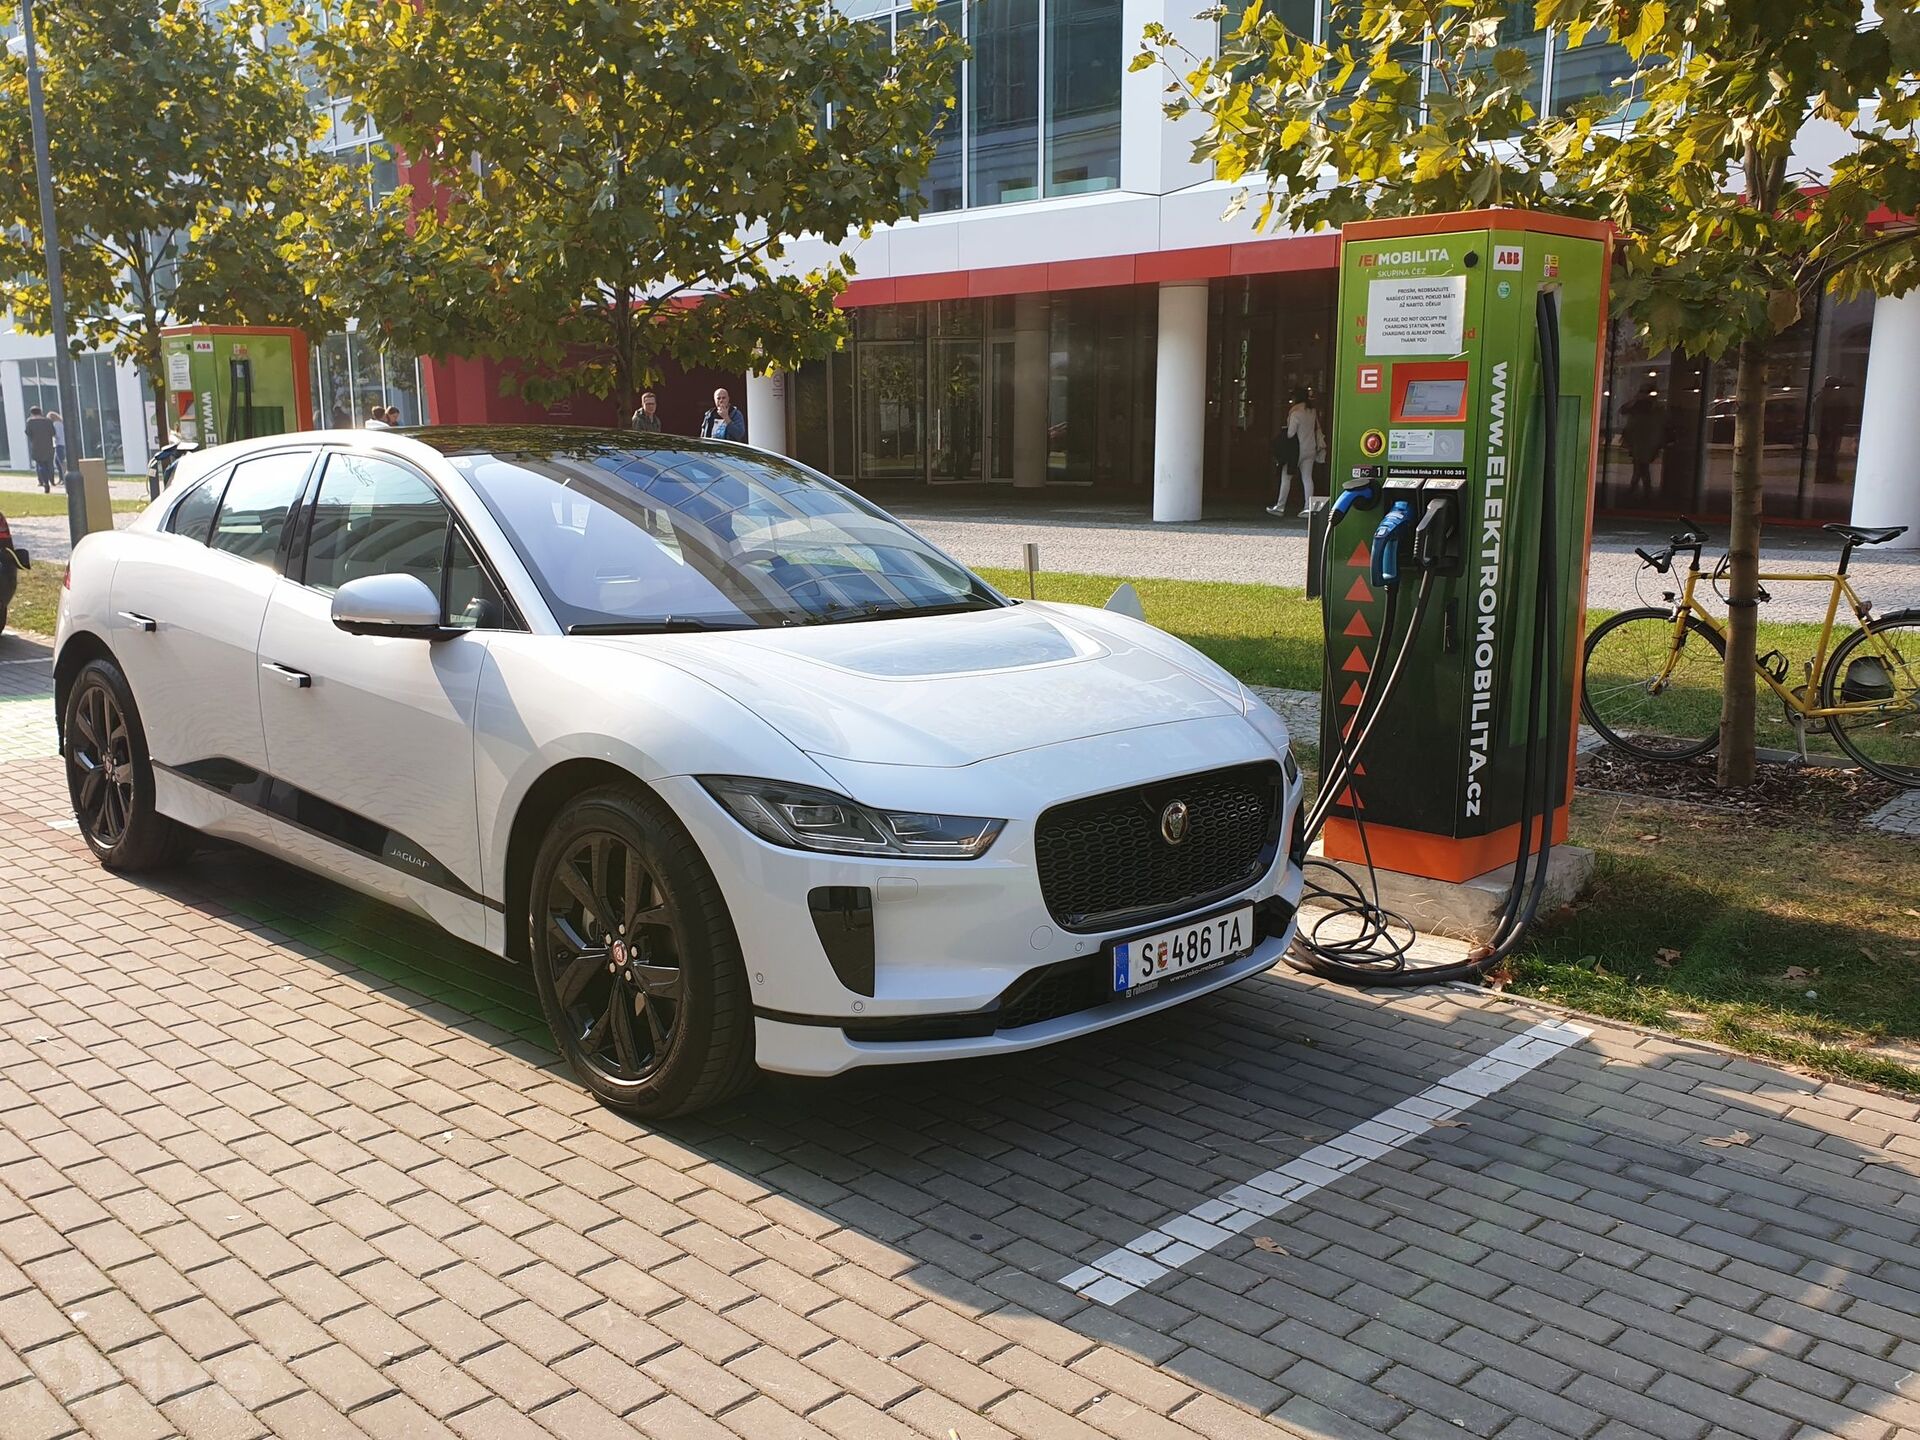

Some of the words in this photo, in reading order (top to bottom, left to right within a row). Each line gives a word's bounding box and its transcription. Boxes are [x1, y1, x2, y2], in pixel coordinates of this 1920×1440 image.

[1498, 251, 1520, 265] ABB
[1377, 270, 1410, 278] SKUPINA
[1142, 942, 1154, 978] S
[1172, 926, 1212, 968] 486
[1218, 916, 1242, 954] TA
[1118, 974, 1126, 985] A
